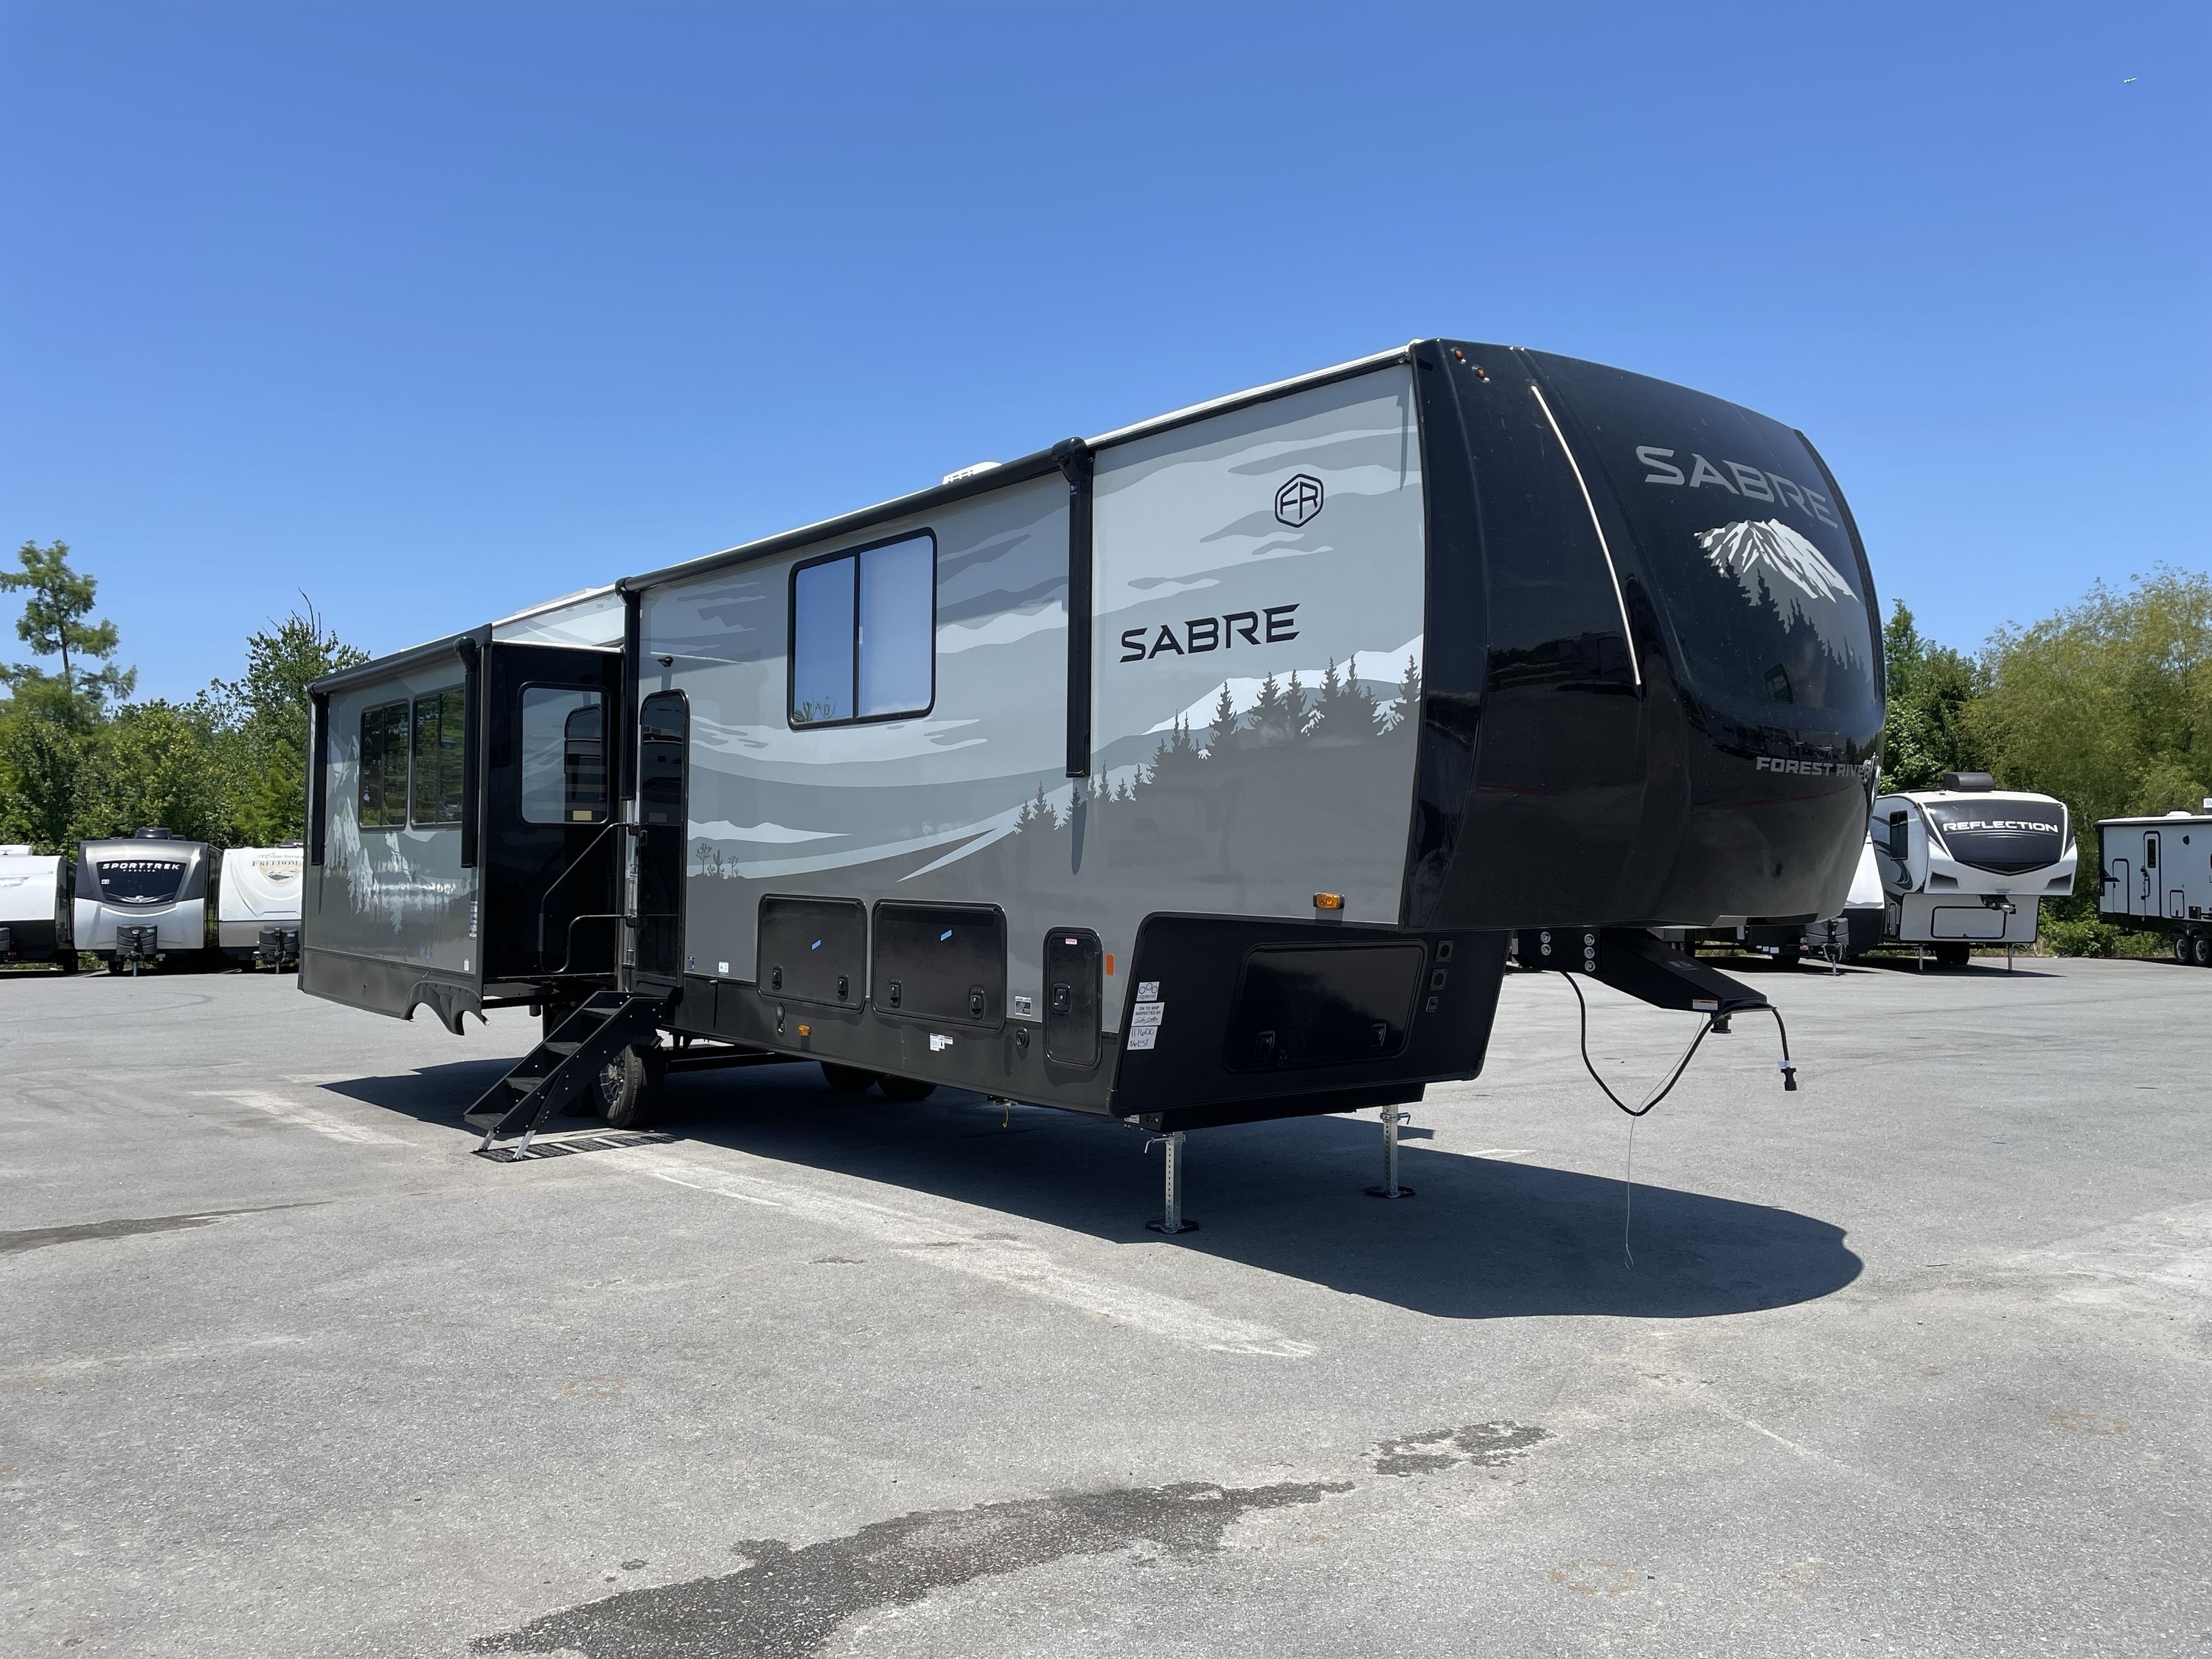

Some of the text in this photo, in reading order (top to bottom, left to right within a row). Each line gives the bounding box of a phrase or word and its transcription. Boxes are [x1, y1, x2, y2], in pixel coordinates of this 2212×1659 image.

[1280, 480, 1319, 521] FR
[1635, 445, 1838, 529] SABRE
[1119, 602, 1301, 664] SABRE
[1756, 756, 1834, 776] FOREST
[1942, 820, 2059, 833] REFLECTION
[102, 862, 181, 870] SPORTTREK
